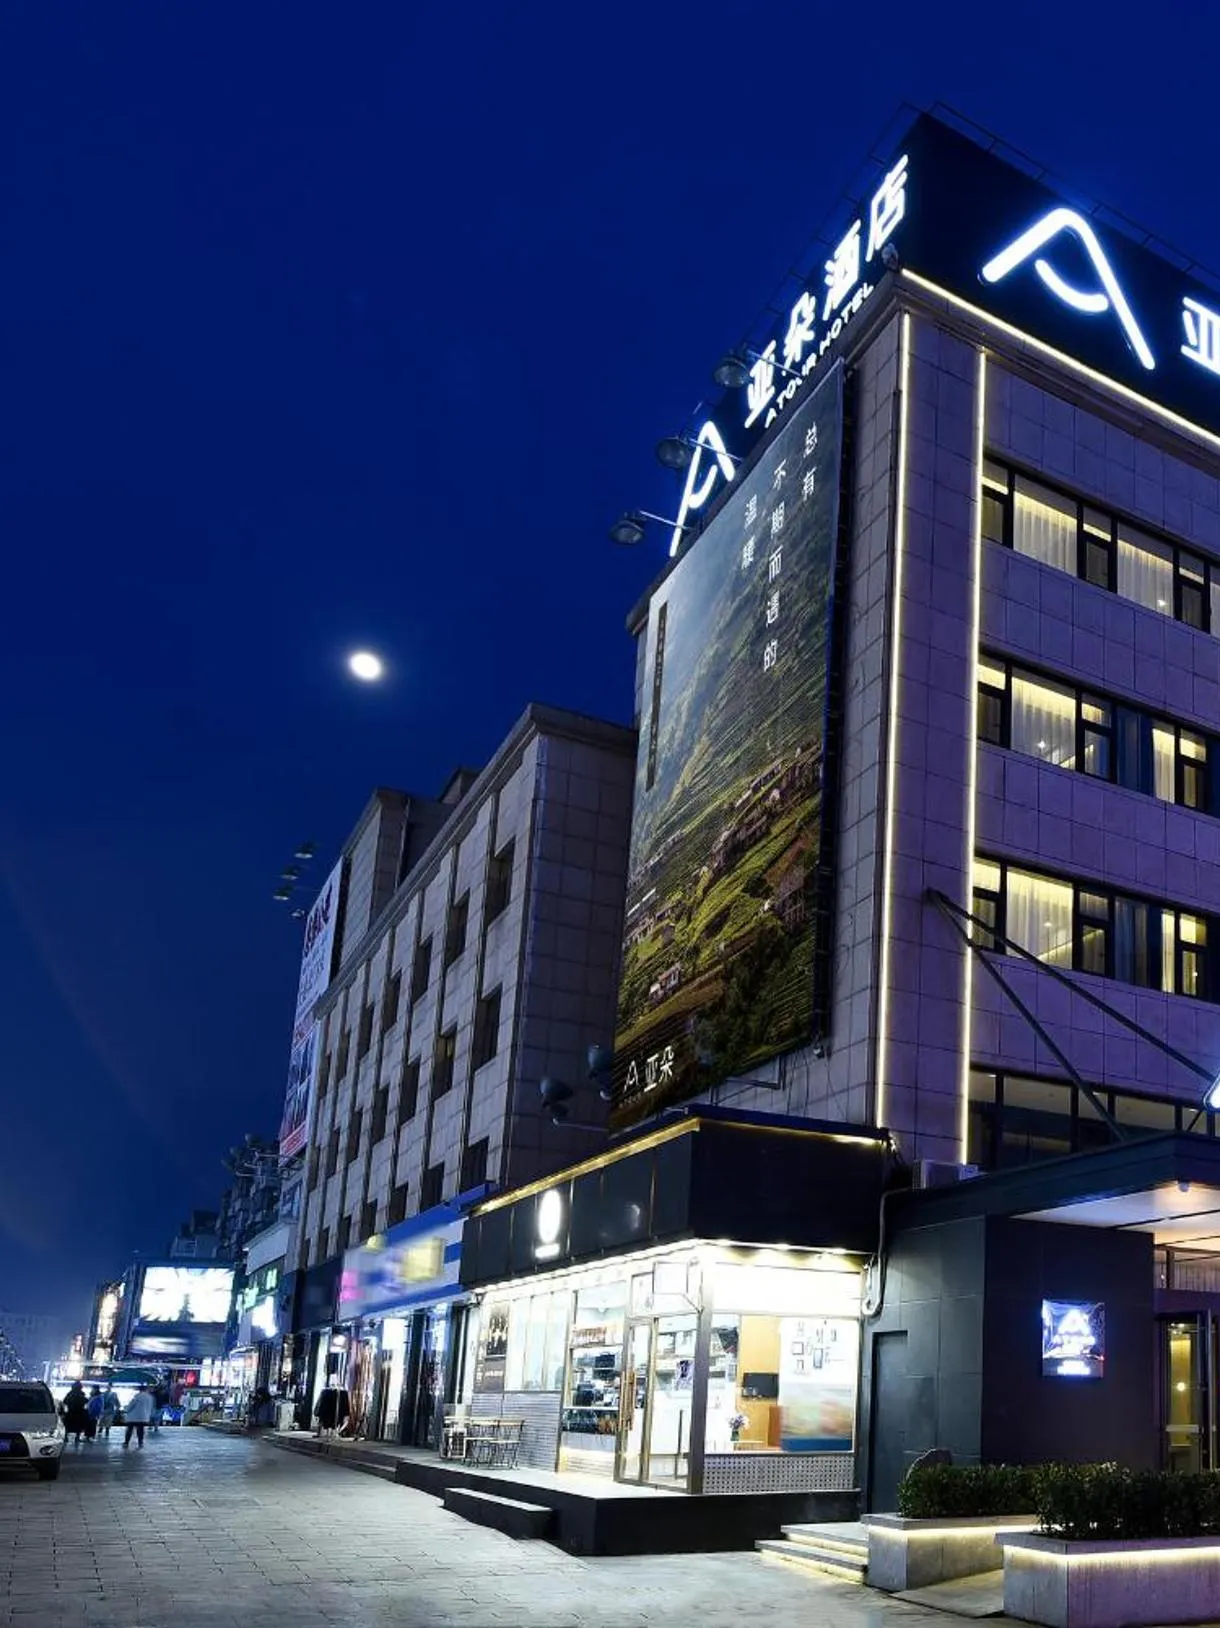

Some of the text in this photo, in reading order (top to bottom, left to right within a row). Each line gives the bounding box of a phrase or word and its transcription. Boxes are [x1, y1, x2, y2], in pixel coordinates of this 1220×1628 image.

[745, 153, 909, 429] 亚朵酒店
[819, 282, 875, 356] HOTEL
[803, 422, 818, 501] 总有
[643, 1045, 675, 1093] 亚朵
